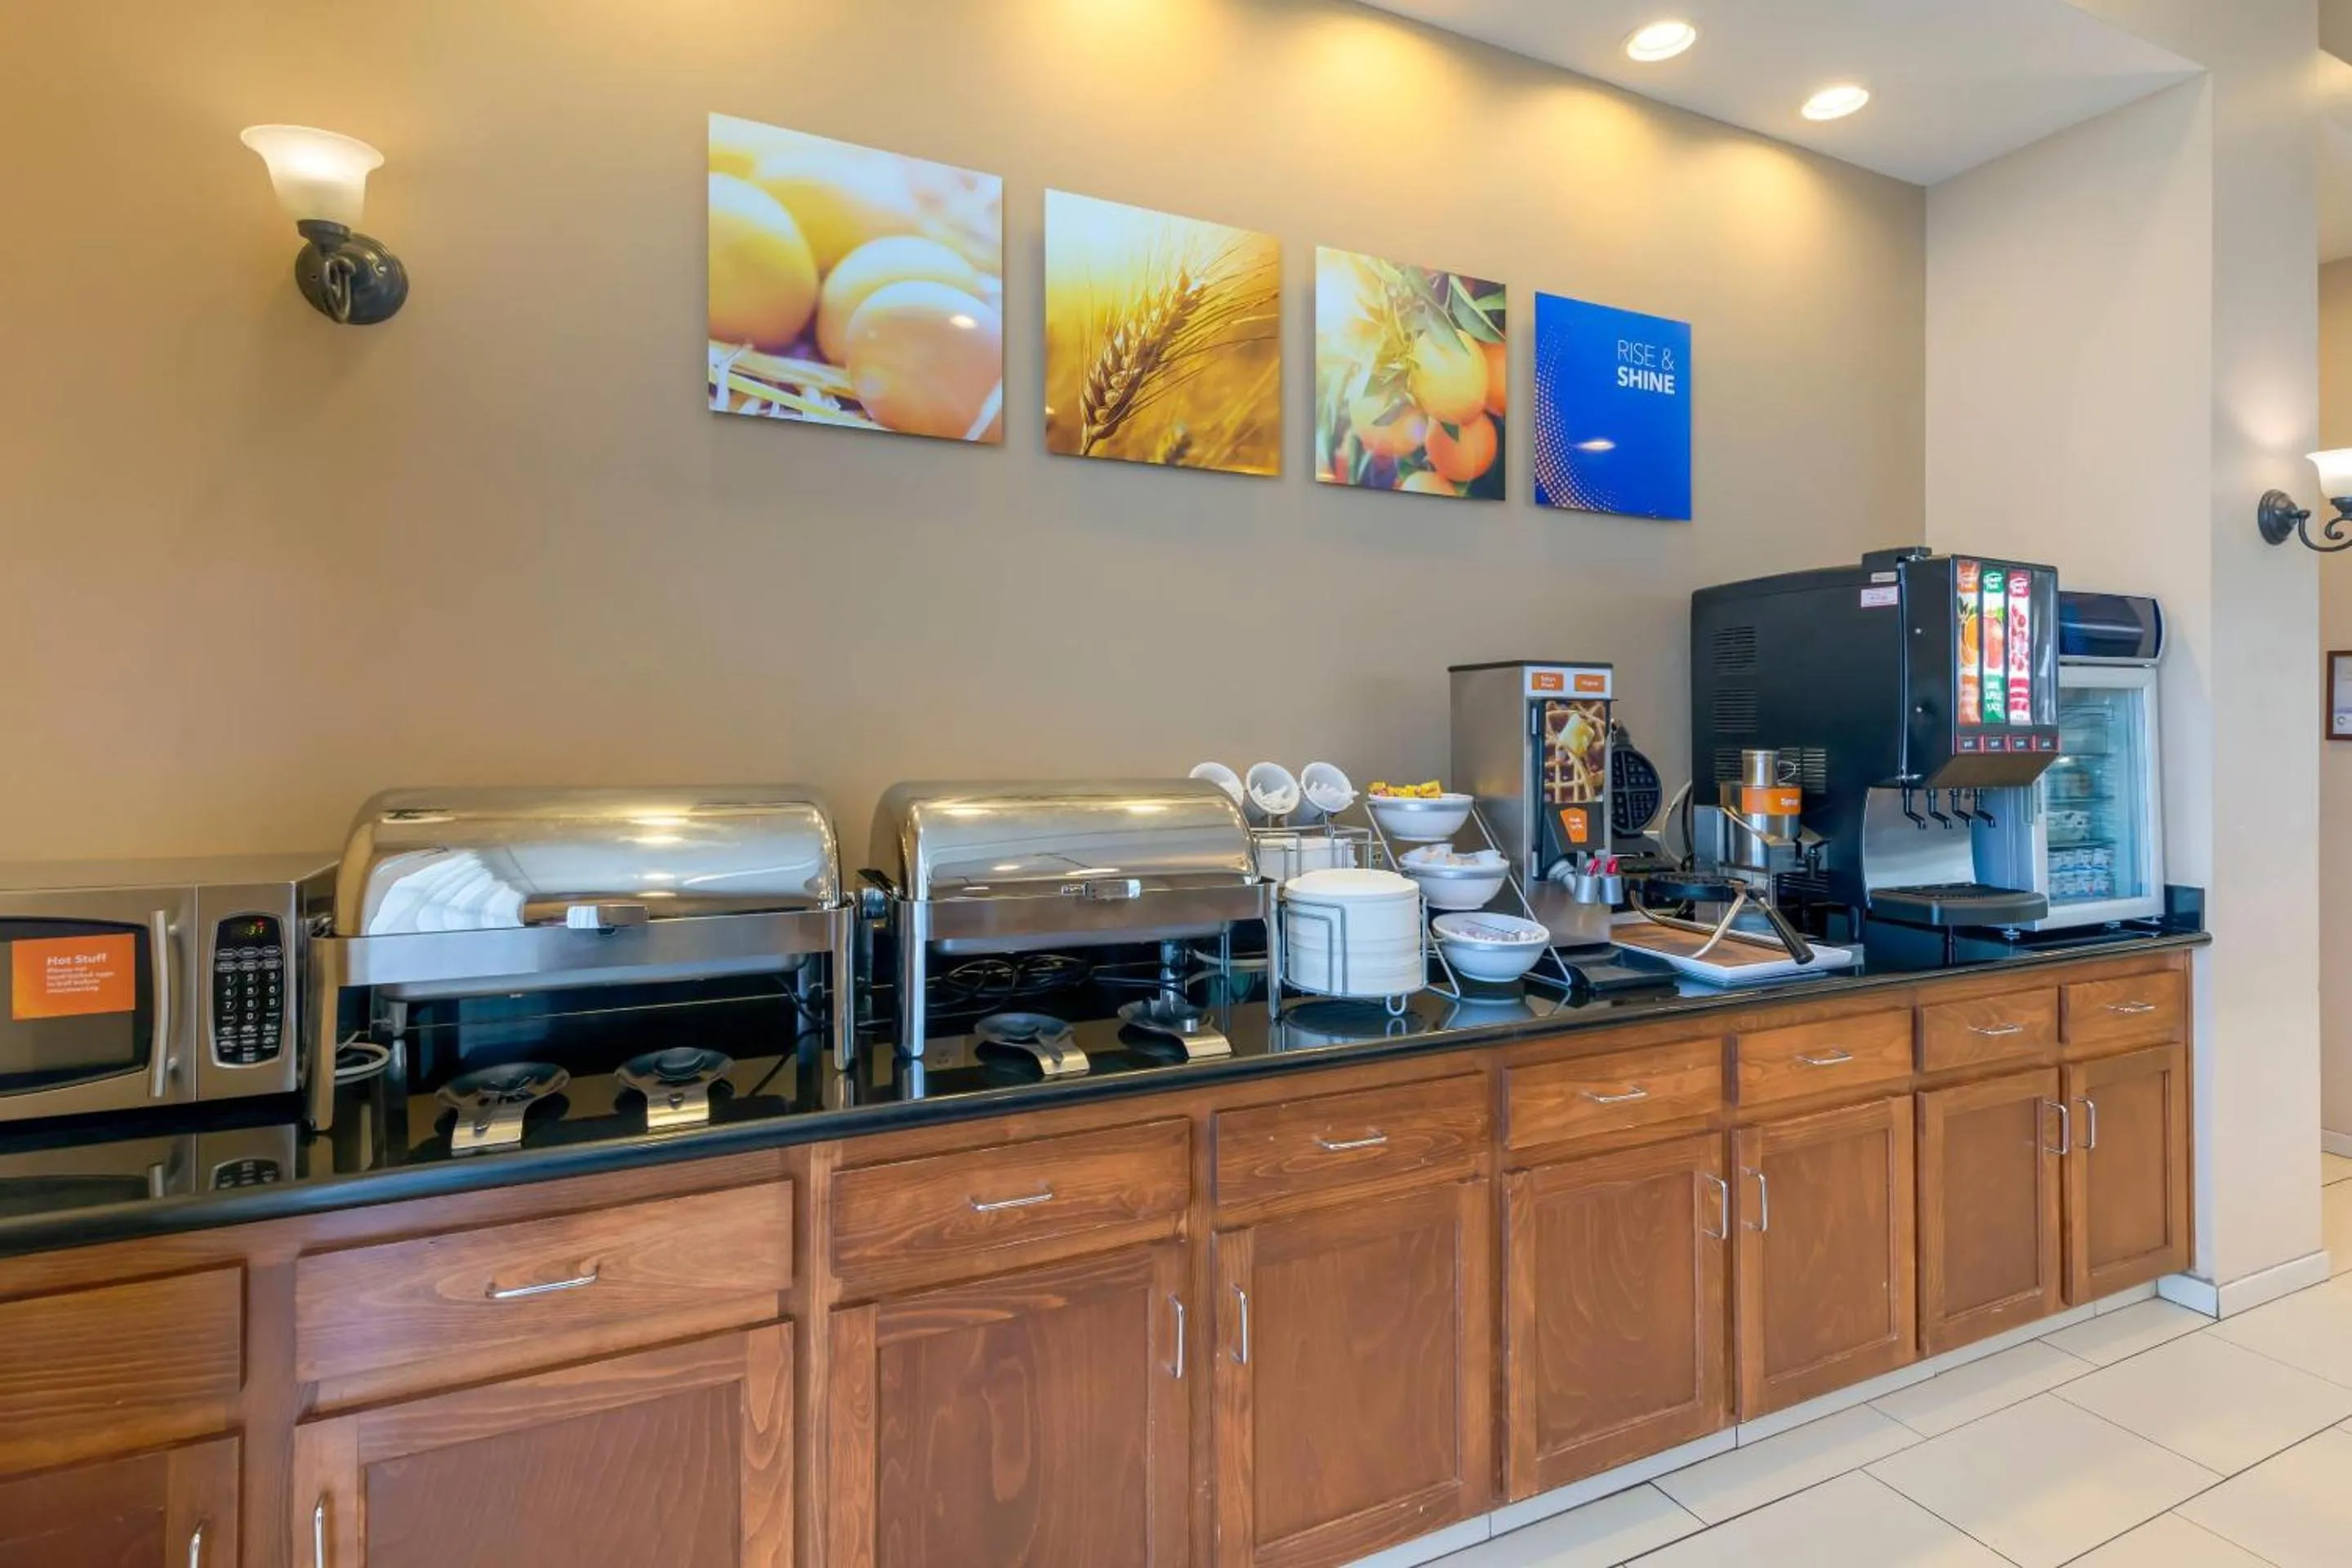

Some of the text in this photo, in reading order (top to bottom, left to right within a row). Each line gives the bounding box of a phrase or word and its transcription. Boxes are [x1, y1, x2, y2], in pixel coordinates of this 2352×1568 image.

[1617, 339, 1674, 371] RISE &
[1617, 366, 1675, 394] SHINE
[47, 952, 107, 965] Hot Stuff
